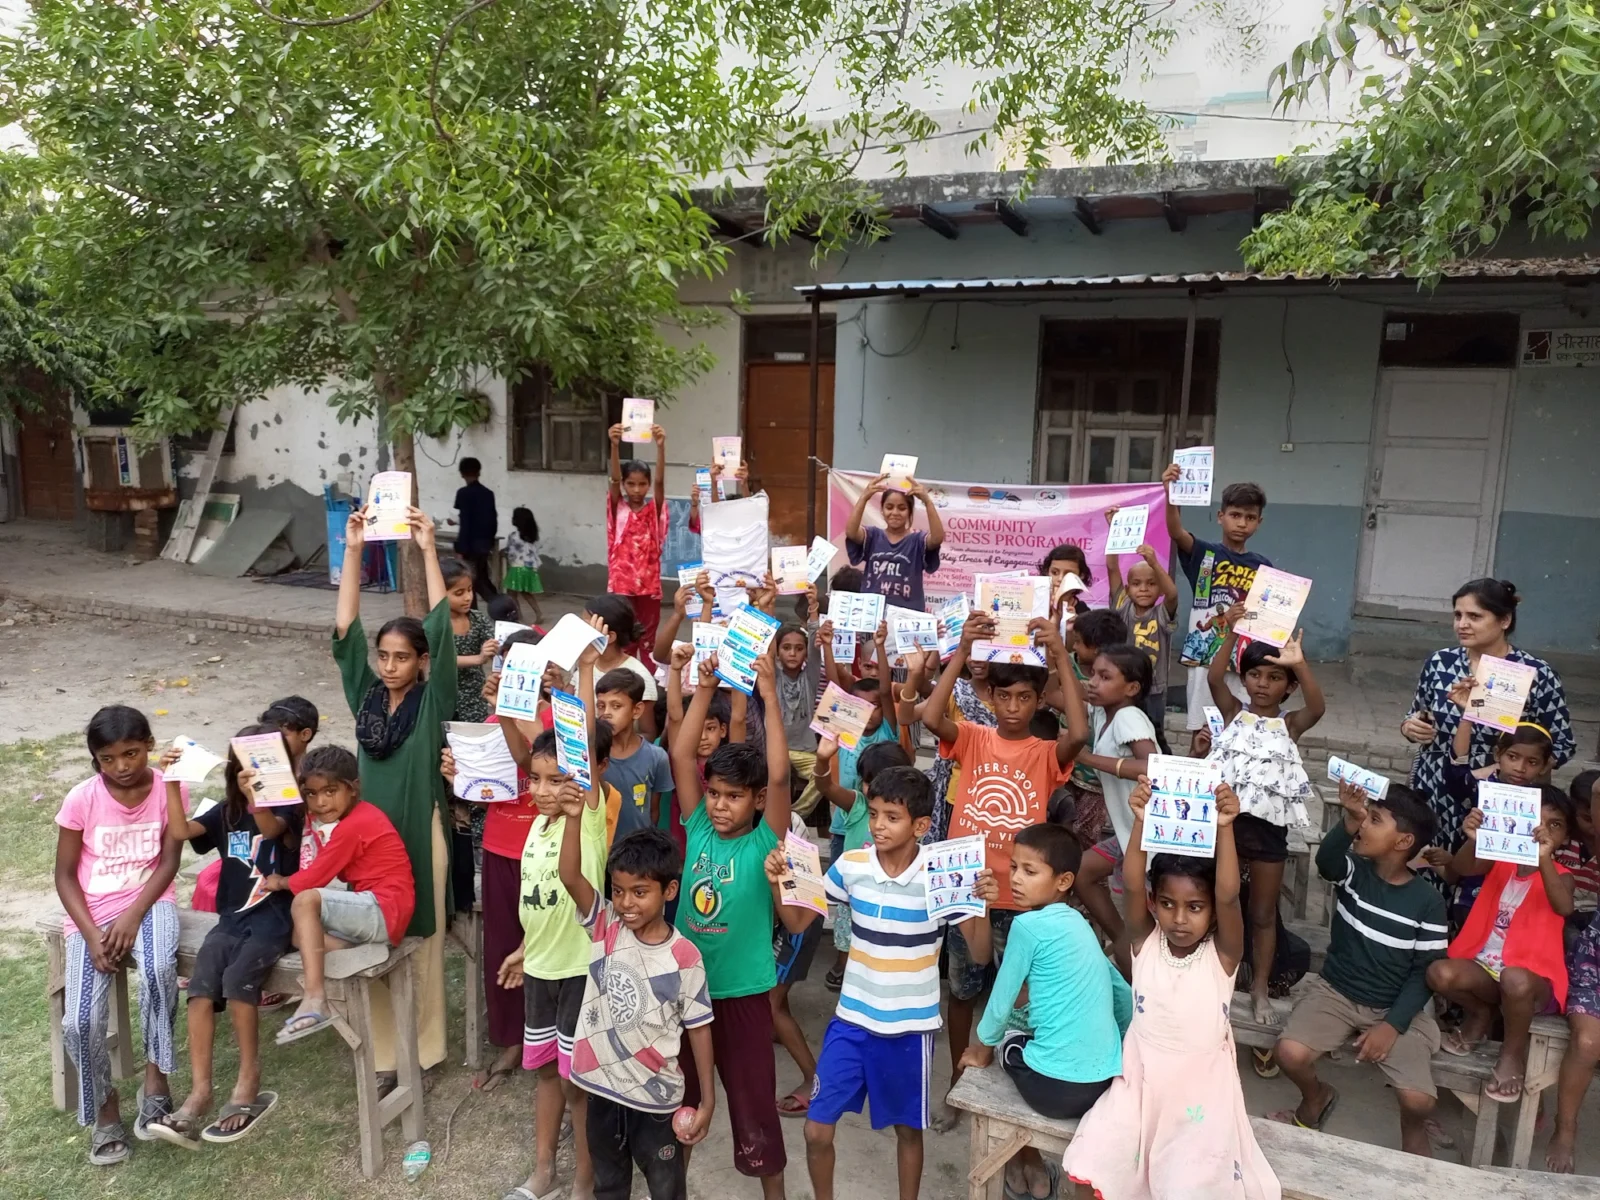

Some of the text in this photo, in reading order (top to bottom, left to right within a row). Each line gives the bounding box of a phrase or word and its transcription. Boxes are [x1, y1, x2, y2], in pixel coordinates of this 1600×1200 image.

[948, 517, 1036, 533] COMMUNITY
[943, 531, 1093, 551] ENESS PROGRAMME
[940, 553, 956, 565] Key
[958, 553, 982, 563] Areas
[983, 555, 993, 566] of
[1216, 561, 1258, 580] CAPTA
[1012, 769, 1040, 810] SPORT
